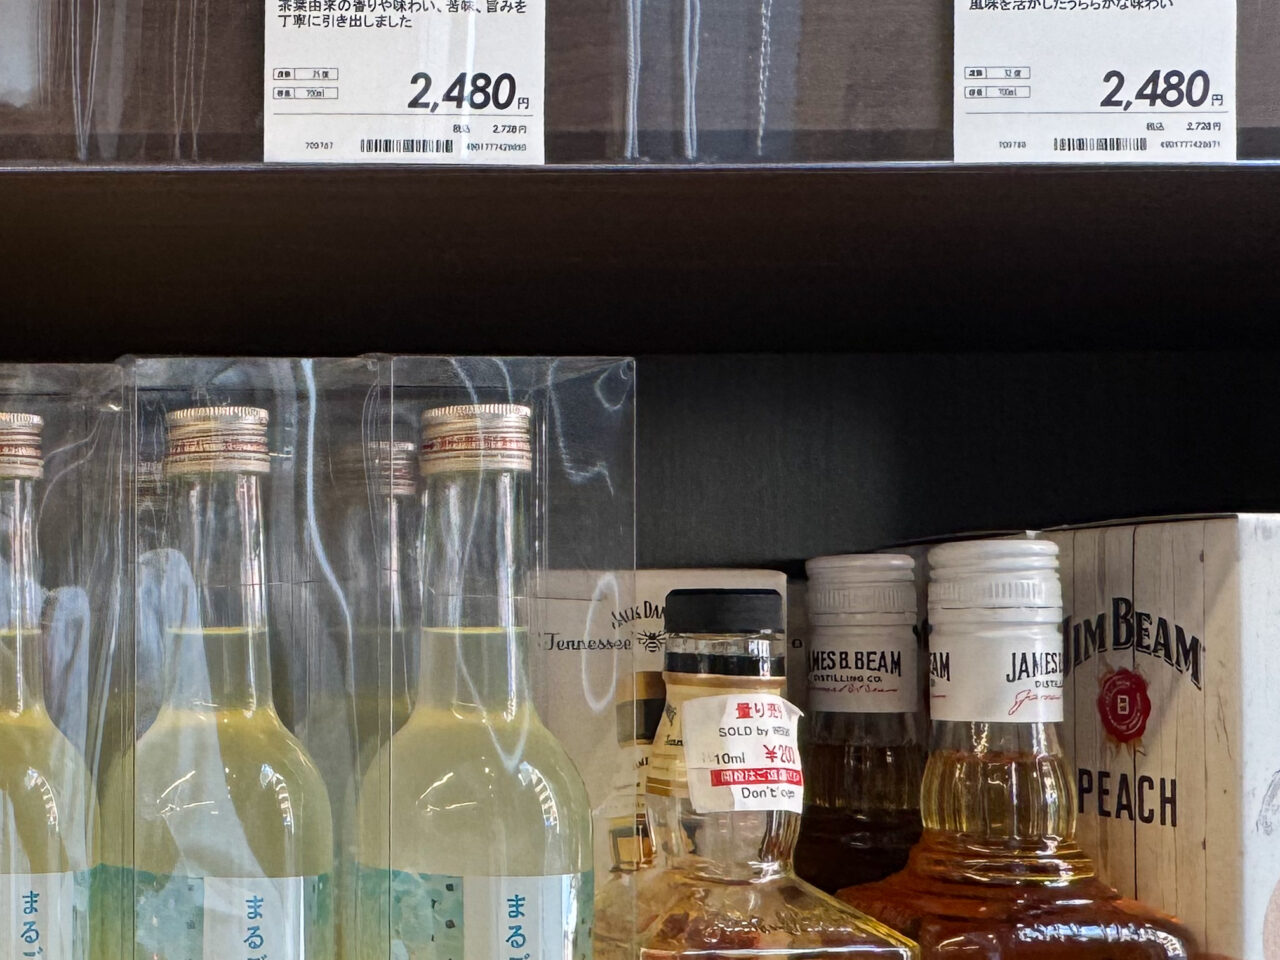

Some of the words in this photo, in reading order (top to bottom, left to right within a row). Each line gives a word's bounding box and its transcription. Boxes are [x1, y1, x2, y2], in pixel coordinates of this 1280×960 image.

[278, 14, 412, 28] 丁寧に引き出しました
[1111, 596, 1203, 691] BEAM
[854, 651, 902, 677] BEAM
[719, 727, 753, 737] SOLD
[756, 726, 769, 737] by
[741, 786, 777, 799] Don't
[1077, 768, 1177, 828] PEACH
